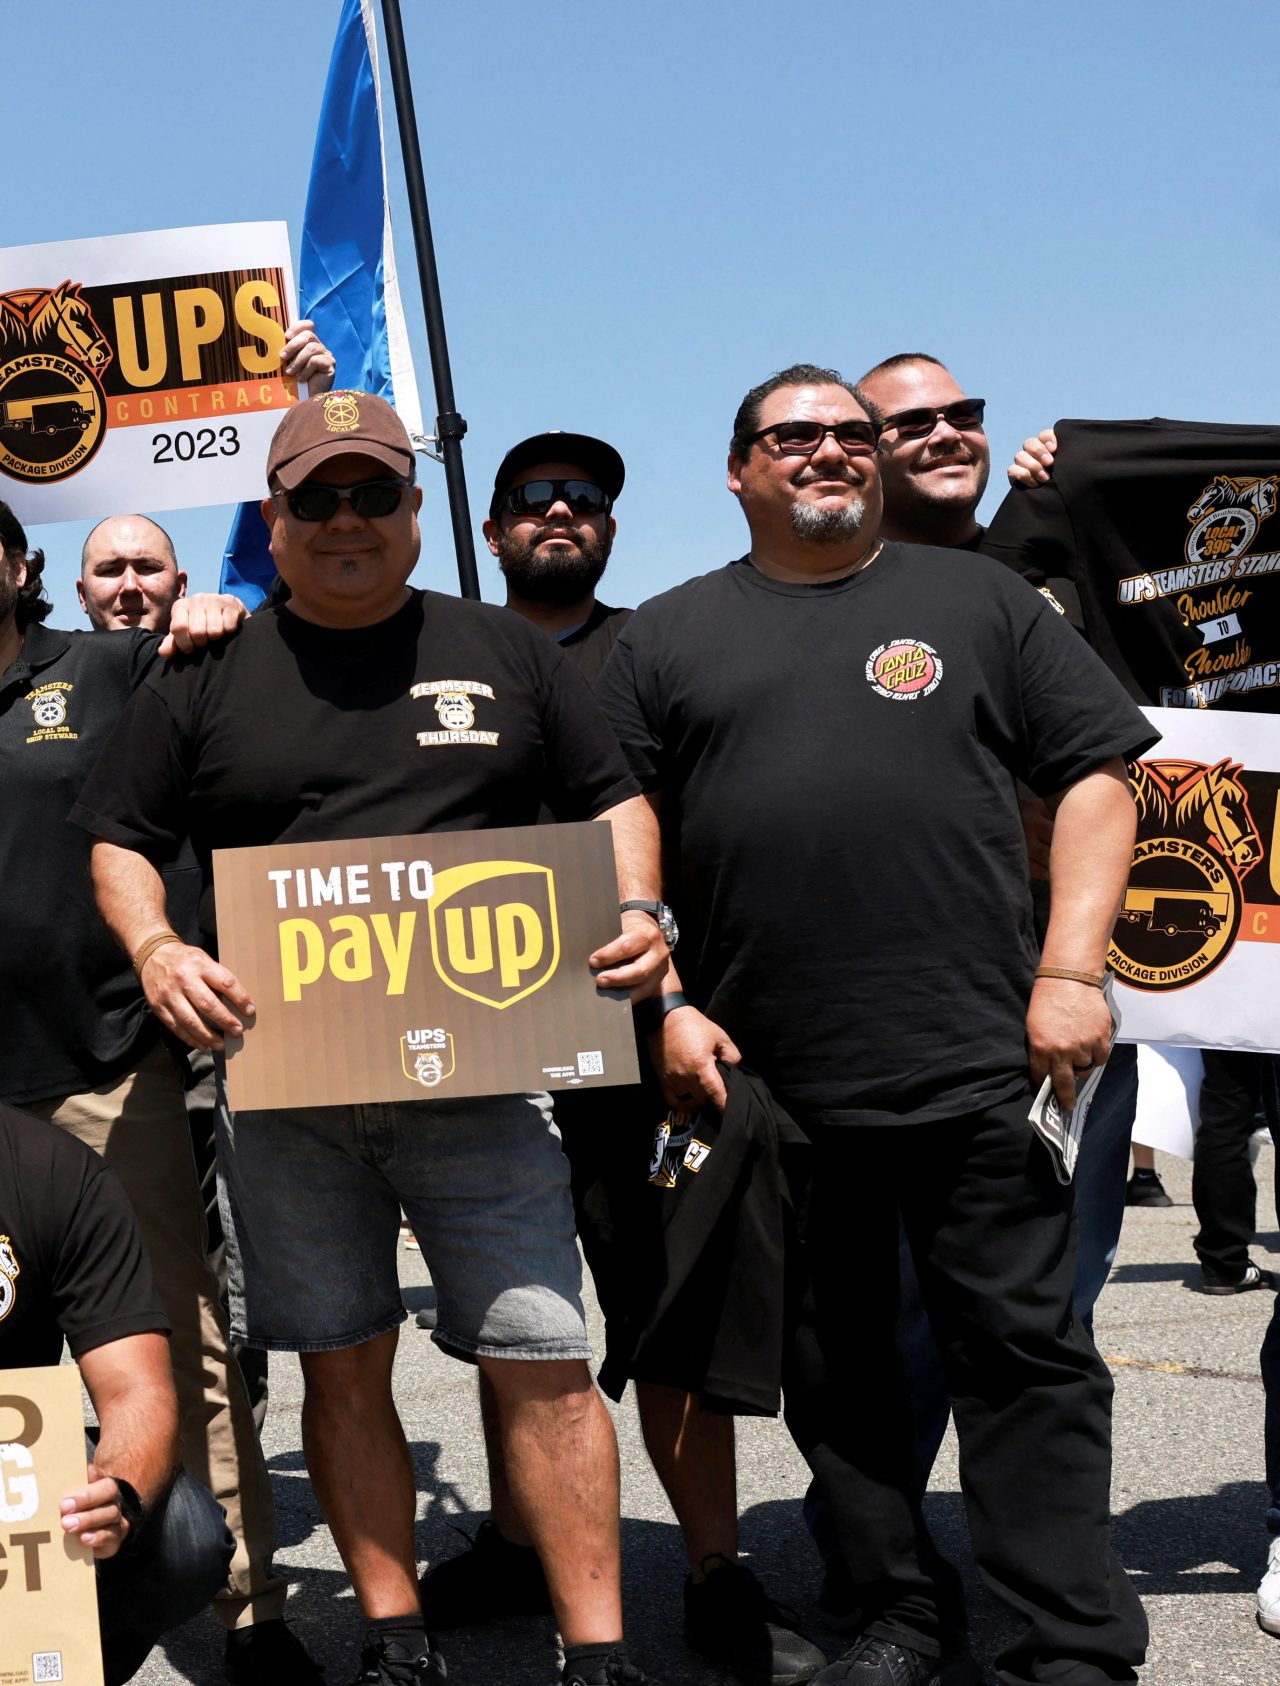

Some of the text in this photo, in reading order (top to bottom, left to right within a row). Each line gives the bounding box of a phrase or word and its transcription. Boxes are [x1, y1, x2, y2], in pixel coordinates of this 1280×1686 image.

[114, 280, 286, 388] UPS
[3, 444, 88, 474] PACKAGE DIVISION
[152, 426, 240, 464] 2023
[1204, 525, 1240, 540] LOCAL
[1204, 539, 1232, 556] 396
[1120, 576, 1155, 602] UPS
[1152, 560, 1234, 595] TEAMSTERS
[1177, 584, 1254, 626] Shoulder
[1217, 620, 1229, 636] TO
[875, 648, 925, 678] SANTA
[887, 661, 926, 689] CRUZ
[416, 730, 500, 746] THURSDAY
[1134, 841, 1224, 884] AMSTERS
[268, 860, 435, 908] TIME TO
[278, 902, 544, 1002] pay up
[1108, 949, 1156, 980] PACKAGE
[1159, 953, 1209, 981] DIVISION
[406, 1028, 446, 1044] UPS
